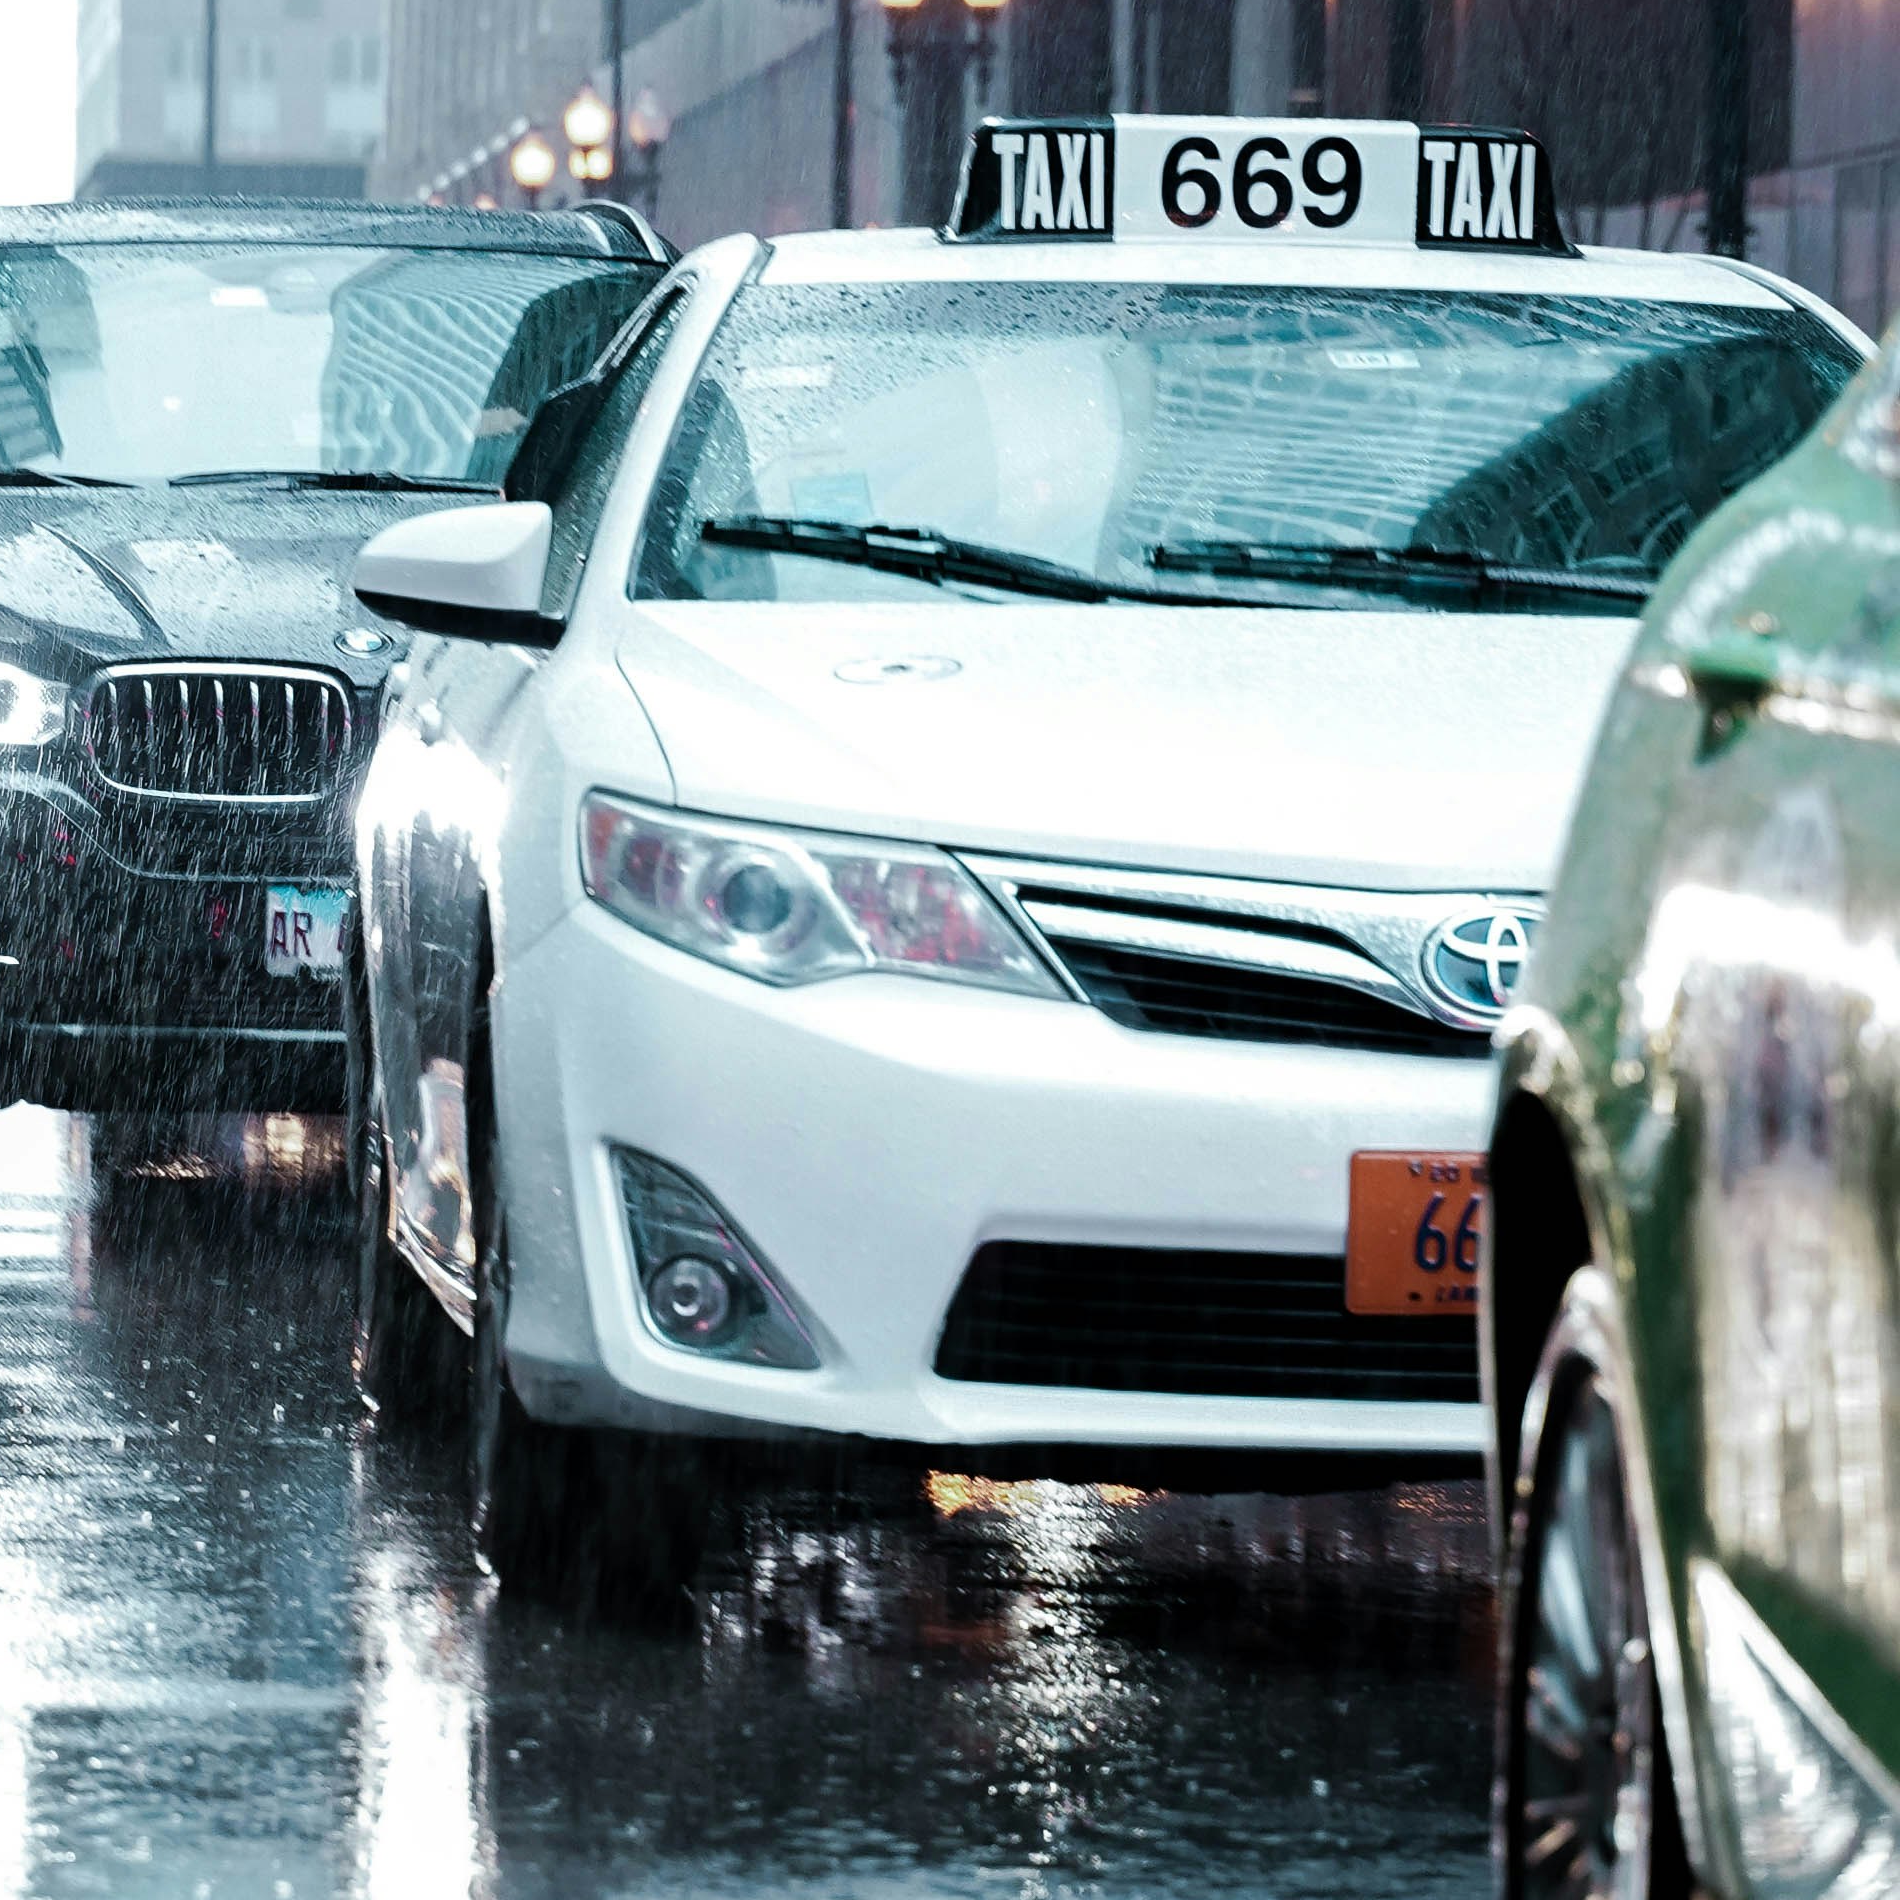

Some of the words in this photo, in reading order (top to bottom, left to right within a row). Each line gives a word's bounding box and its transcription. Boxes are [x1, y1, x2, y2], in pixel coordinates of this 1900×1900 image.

[993, 133, 1106, 231] TAXI
[1161, 137, 1362, 228] 669
[1424, 141, 1536, 240] TAXI
[270, 910, 313, 958] AR
